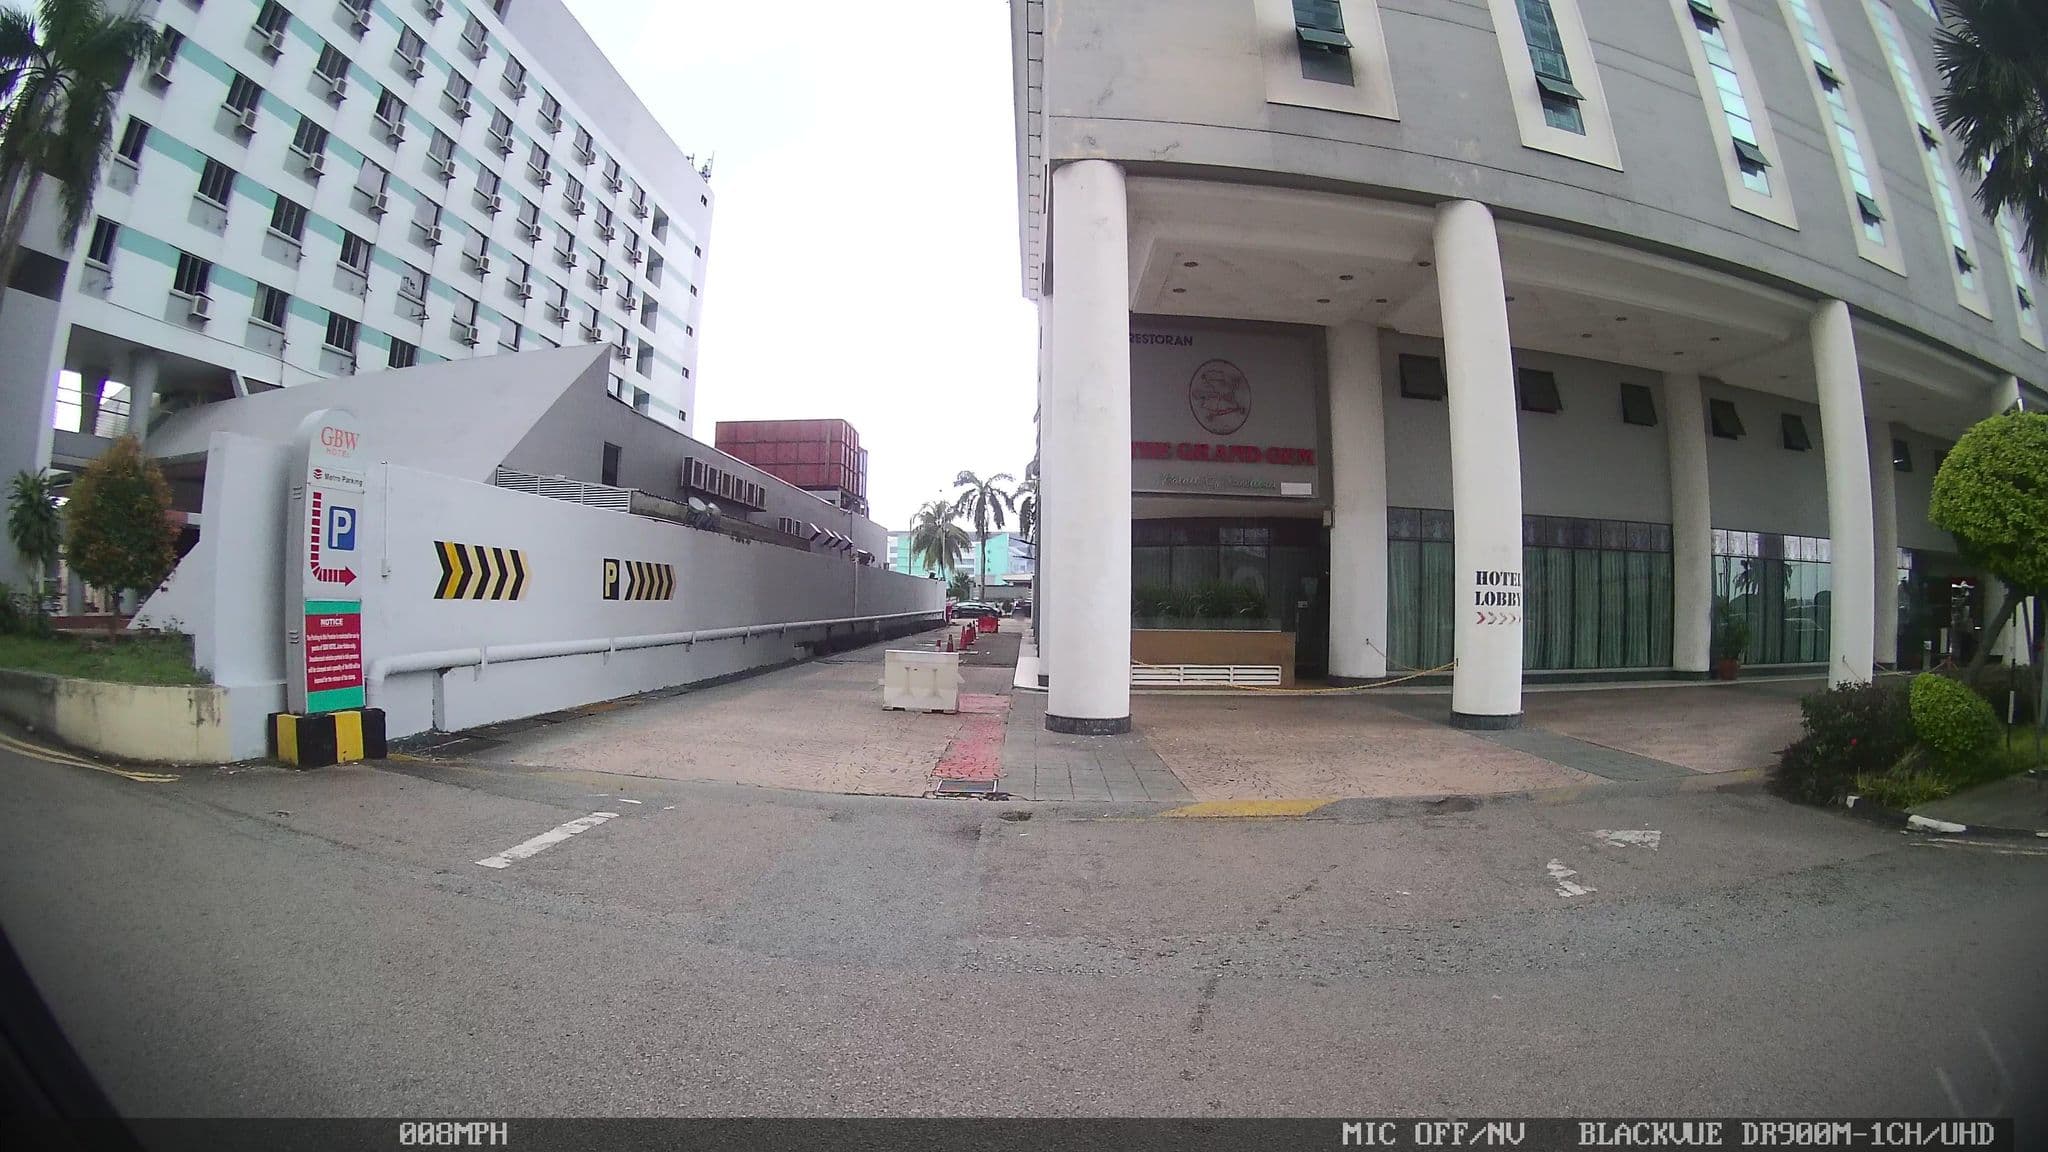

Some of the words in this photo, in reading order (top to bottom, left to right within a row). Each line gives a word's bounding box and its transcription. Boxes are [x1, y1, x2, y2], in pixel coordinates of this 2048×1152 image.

[1130, 334, 1193, 347] RESTORAN
[321, 426, 360, 450] GBW
[326, 448, 350, 458] HOTEL
[1176, 442, 1264, 464] GRAND
[324, 472, 341, 482] Metro
[342, 475, 363, 487] Parking
[331, 509, 352, 548] P
[605, 561, 618, 597] P
[320, 618, 343, 627] NOTICE
